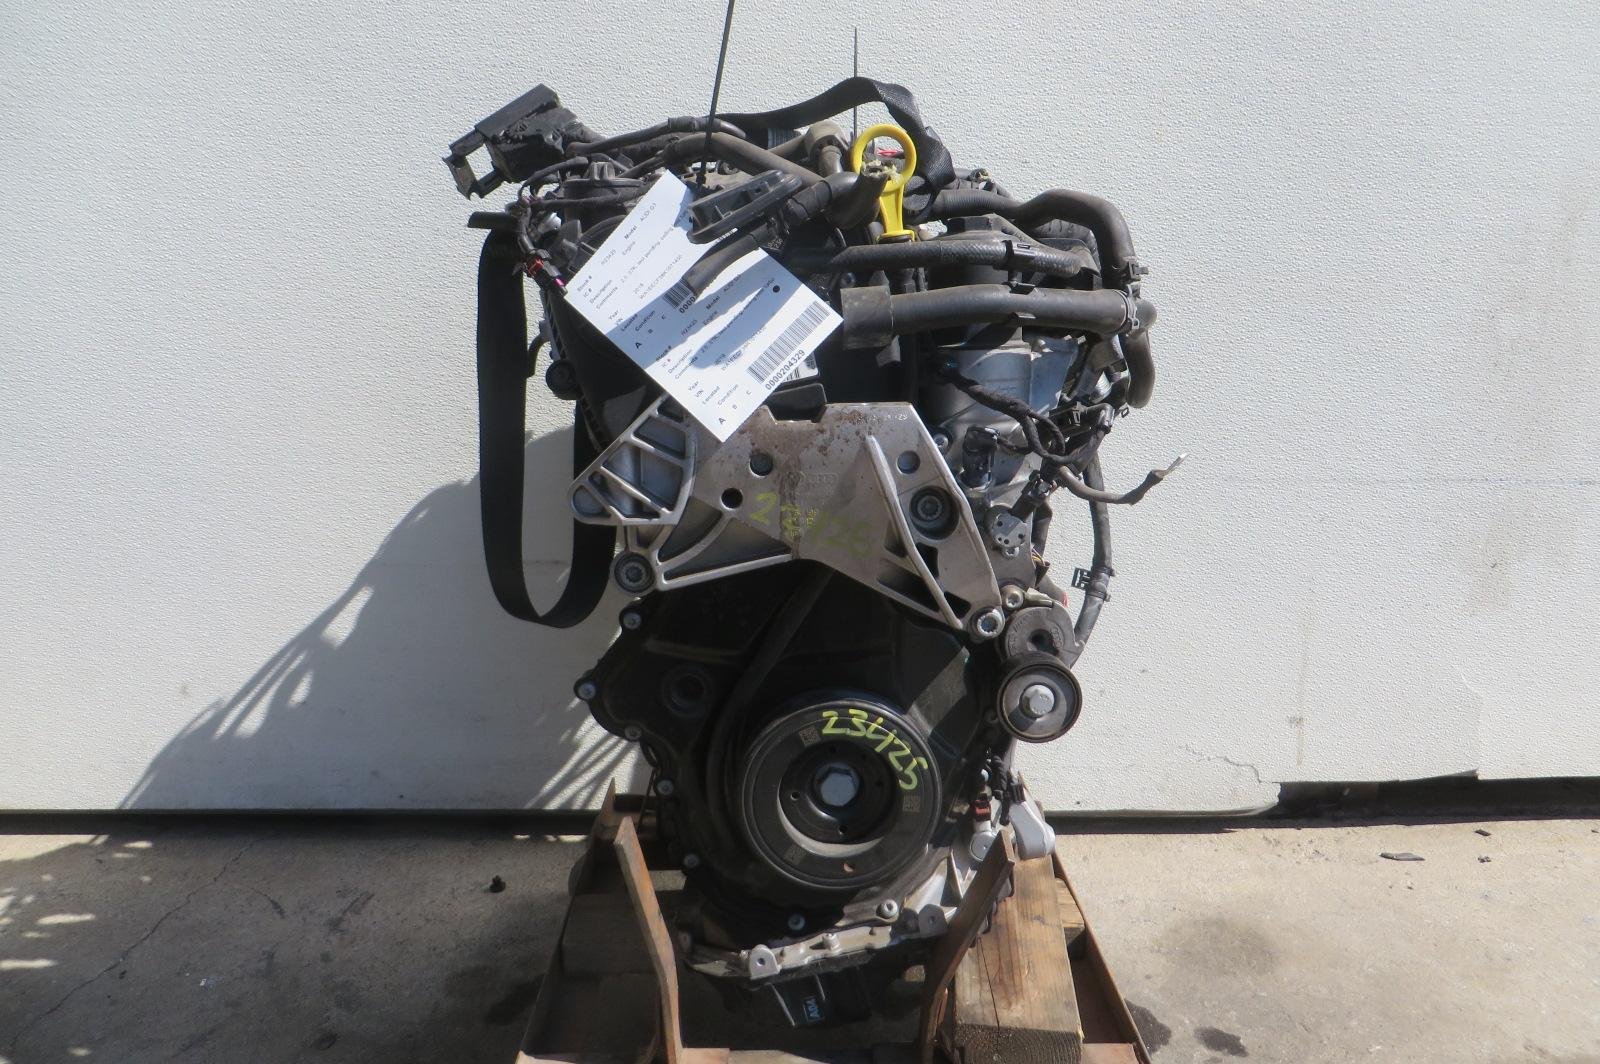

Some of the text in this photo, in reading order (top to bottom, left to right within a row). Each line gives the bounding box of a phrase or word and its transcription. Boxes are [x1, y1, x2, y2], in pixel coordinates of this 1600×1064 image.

[624, 225, 637, 240] Model
[706, 295, 720, 310] Model
[608, 309, 618, 321] Year
[634, 341, 641, 349] A
[668, 349, 692, 374] Description
[765, 349, 806, 391] 0000204329
[687, 380, 698, 392] Year
[694, 388, 703, 398] VIN
[717, 384, 739, 405] Condition
[717, 416, 725, 425] A
